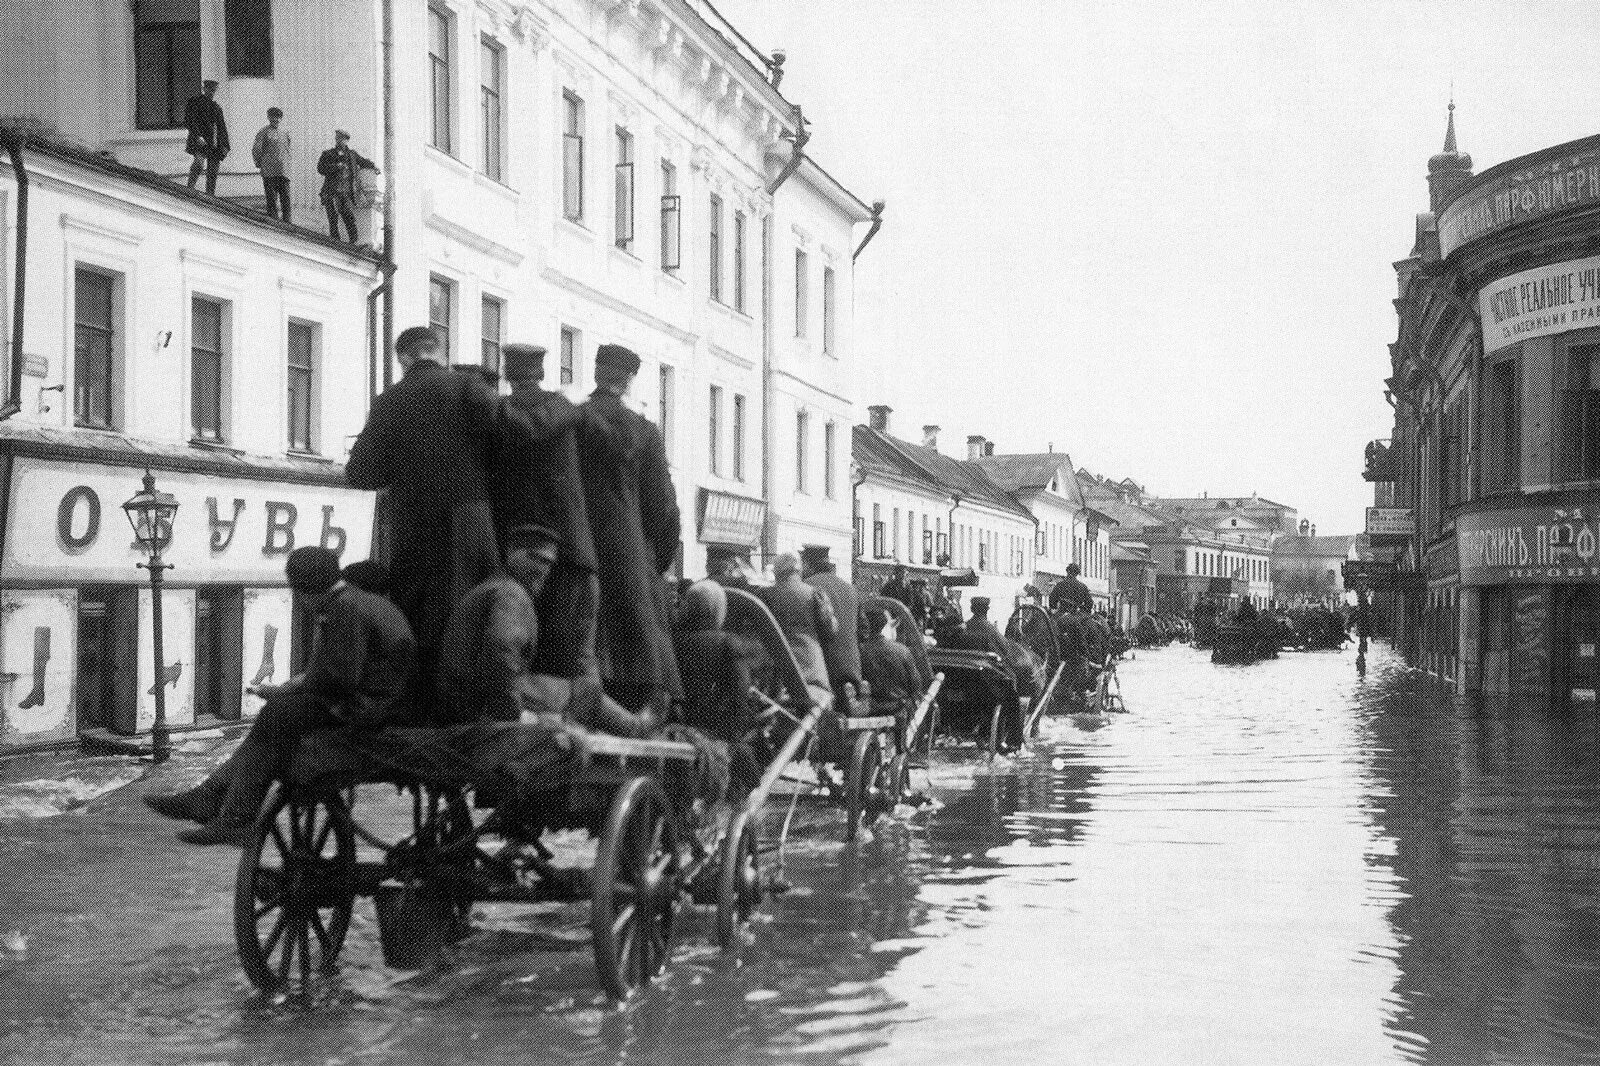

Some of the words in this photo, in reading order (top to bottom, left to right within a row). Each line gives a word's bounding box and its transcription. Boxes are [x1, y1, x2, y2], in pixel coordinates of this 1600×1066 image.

[1520, 272, 1574, 314] РЕАЛЬНОЕ
[1512, 311, 1567, 334] КАЗЕННЫМИ
[57, 485, 347, 558] ОБУВЬ
